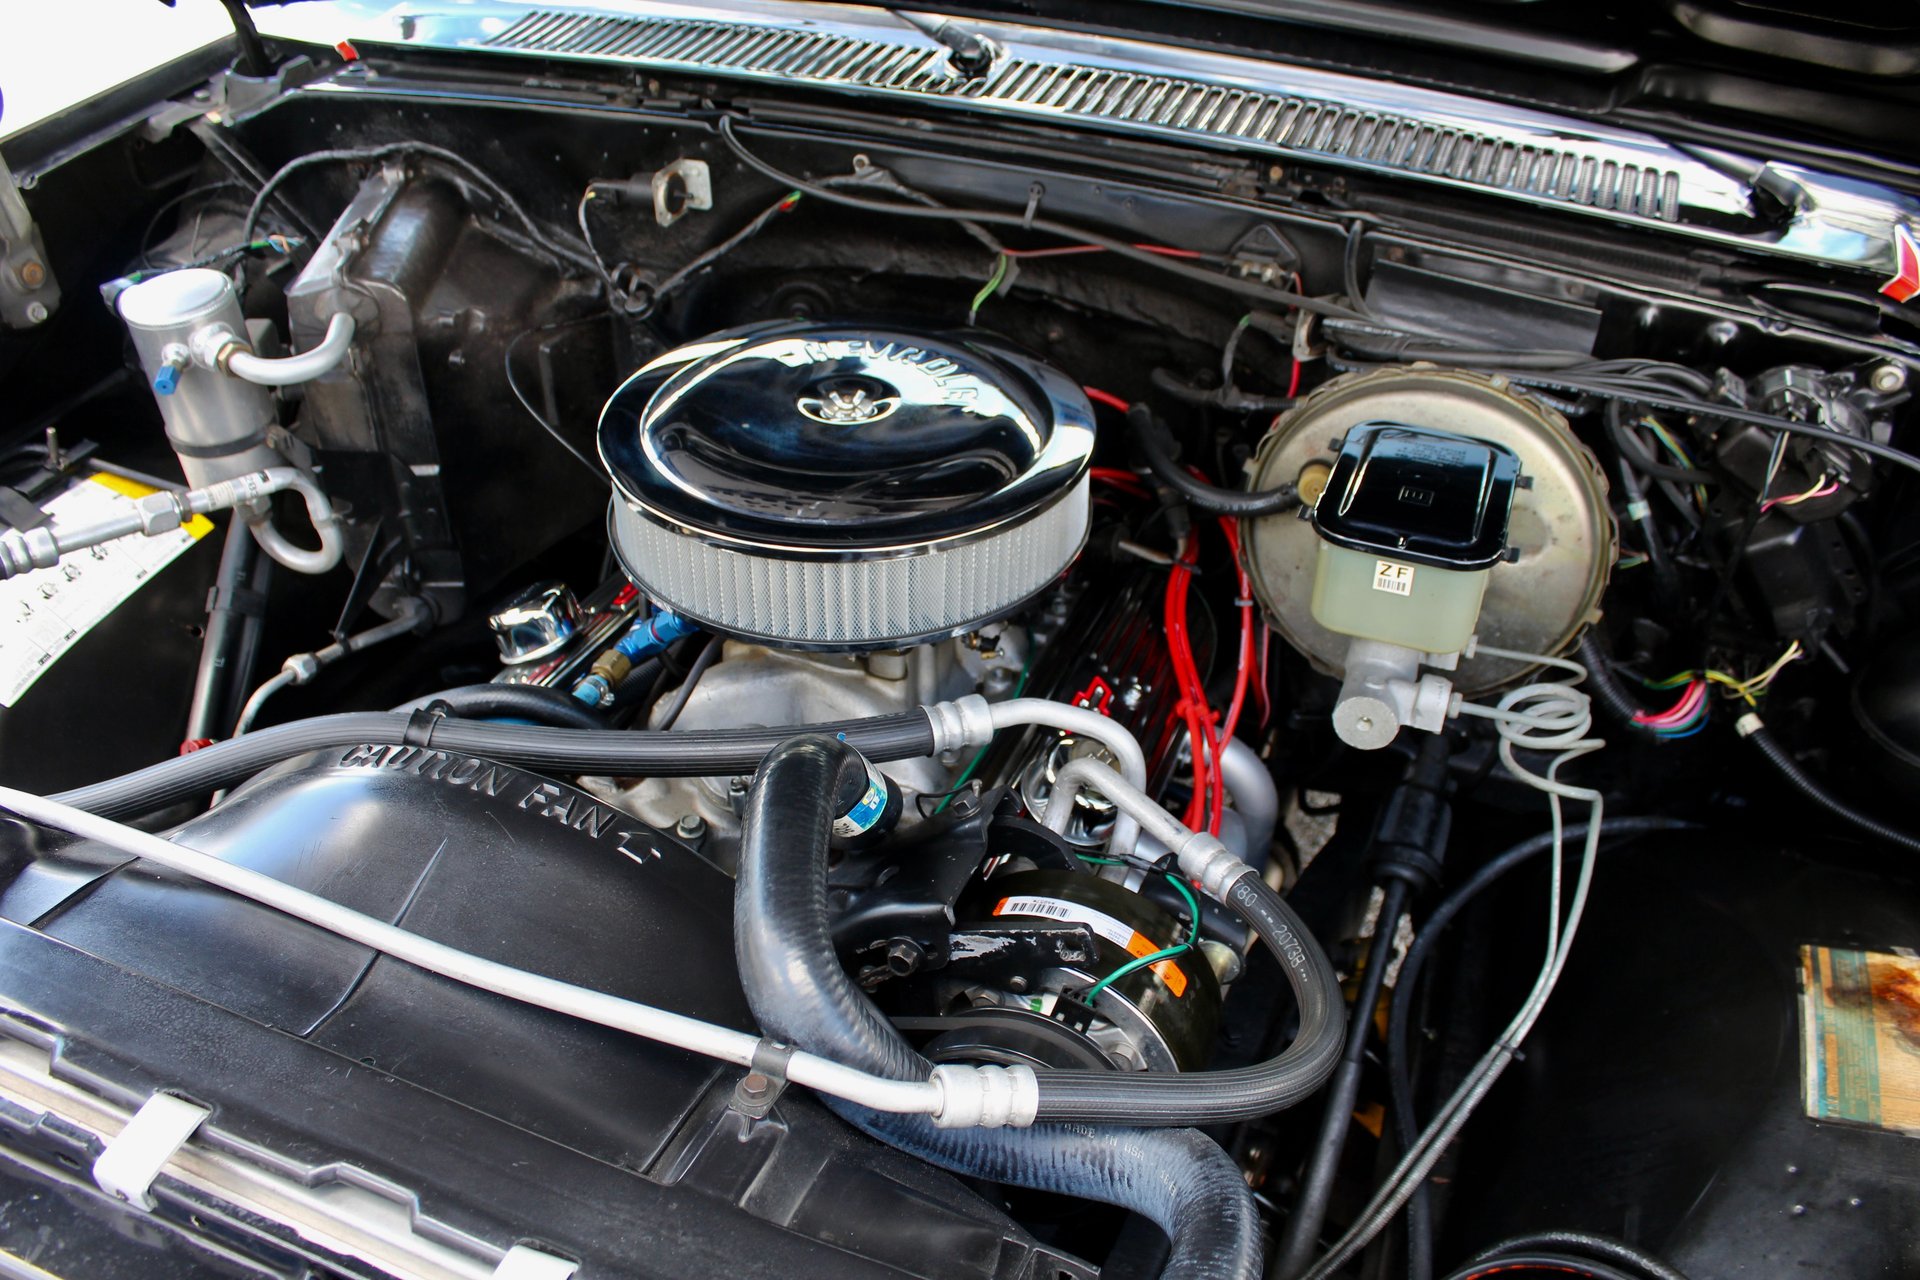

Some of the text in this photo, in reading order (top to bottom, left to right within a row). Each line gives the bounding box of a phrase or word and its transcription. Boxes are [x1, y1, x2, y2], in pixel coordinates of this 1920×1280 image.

[339, 743, 617, 839] CAUTION FAN
[1064, 1123, 1096, 1139] MADE
[1104, 1134, 1118, 1147] IN
[1124, 1143, 1145, 1161] USA
